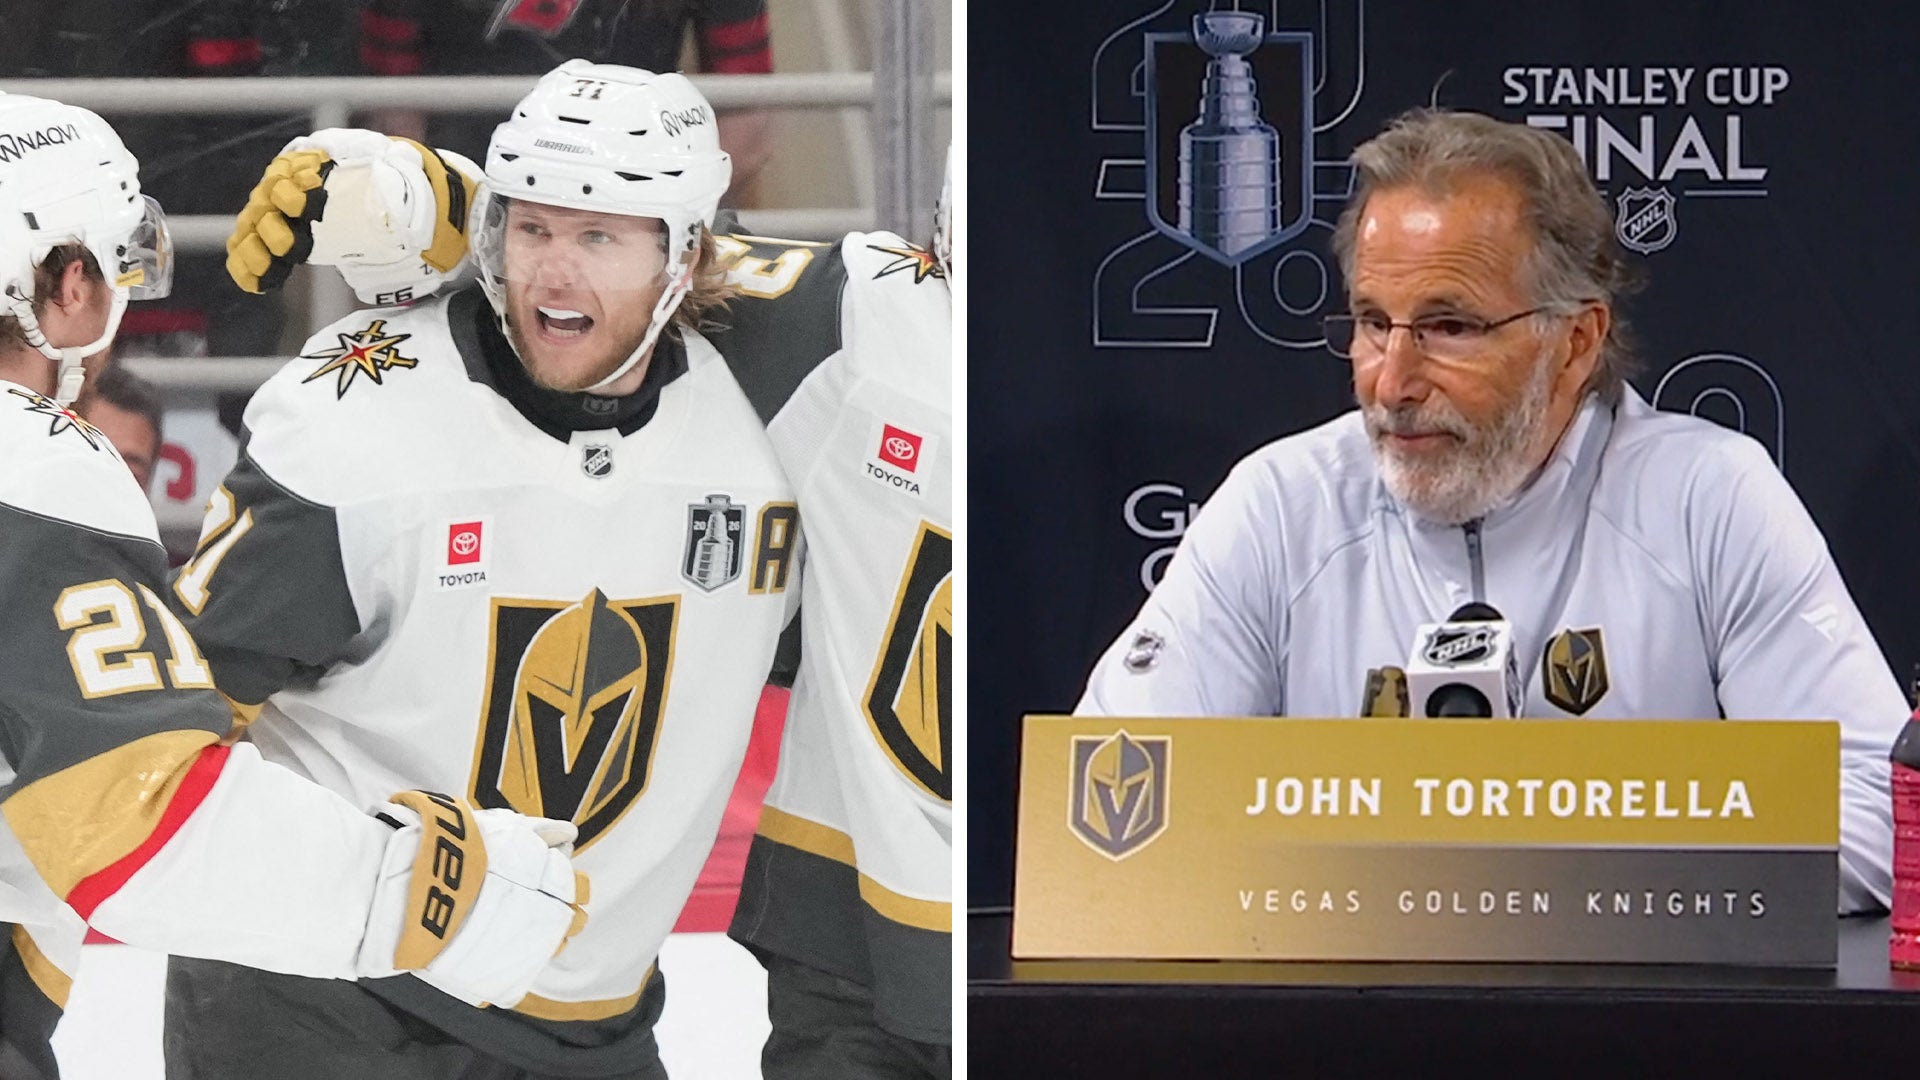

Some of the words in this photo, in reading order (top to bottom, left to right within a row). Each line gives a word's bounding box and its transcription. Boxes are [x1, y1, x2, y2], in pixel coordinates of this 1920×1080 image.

[569, 79, 608, 100] 71
[1503, 67, 1695, 105] STANLEY
[1706, 67, 1790, 105] CUP
[1629, 203, 1665, 238] NHL
[867, 462, 920, 495] TOYOTA
[693, 520, 706, 531] 20
[728, 520, 740, 531] 26
[748, 501, 798, 595] A
[439, 571, 486, 587] TOYOTA
[53, 578, 216, 699] 21
[1246, 777, 1382, 816] JOHN
[1413, 778, 1755, 818] TORTORELLA
[1239, 890, 1361, 914] VEGAS
[1398, 890, 1549, 914] GOLDEN
[1586, 892, 1766, 916] KNIGHTS
